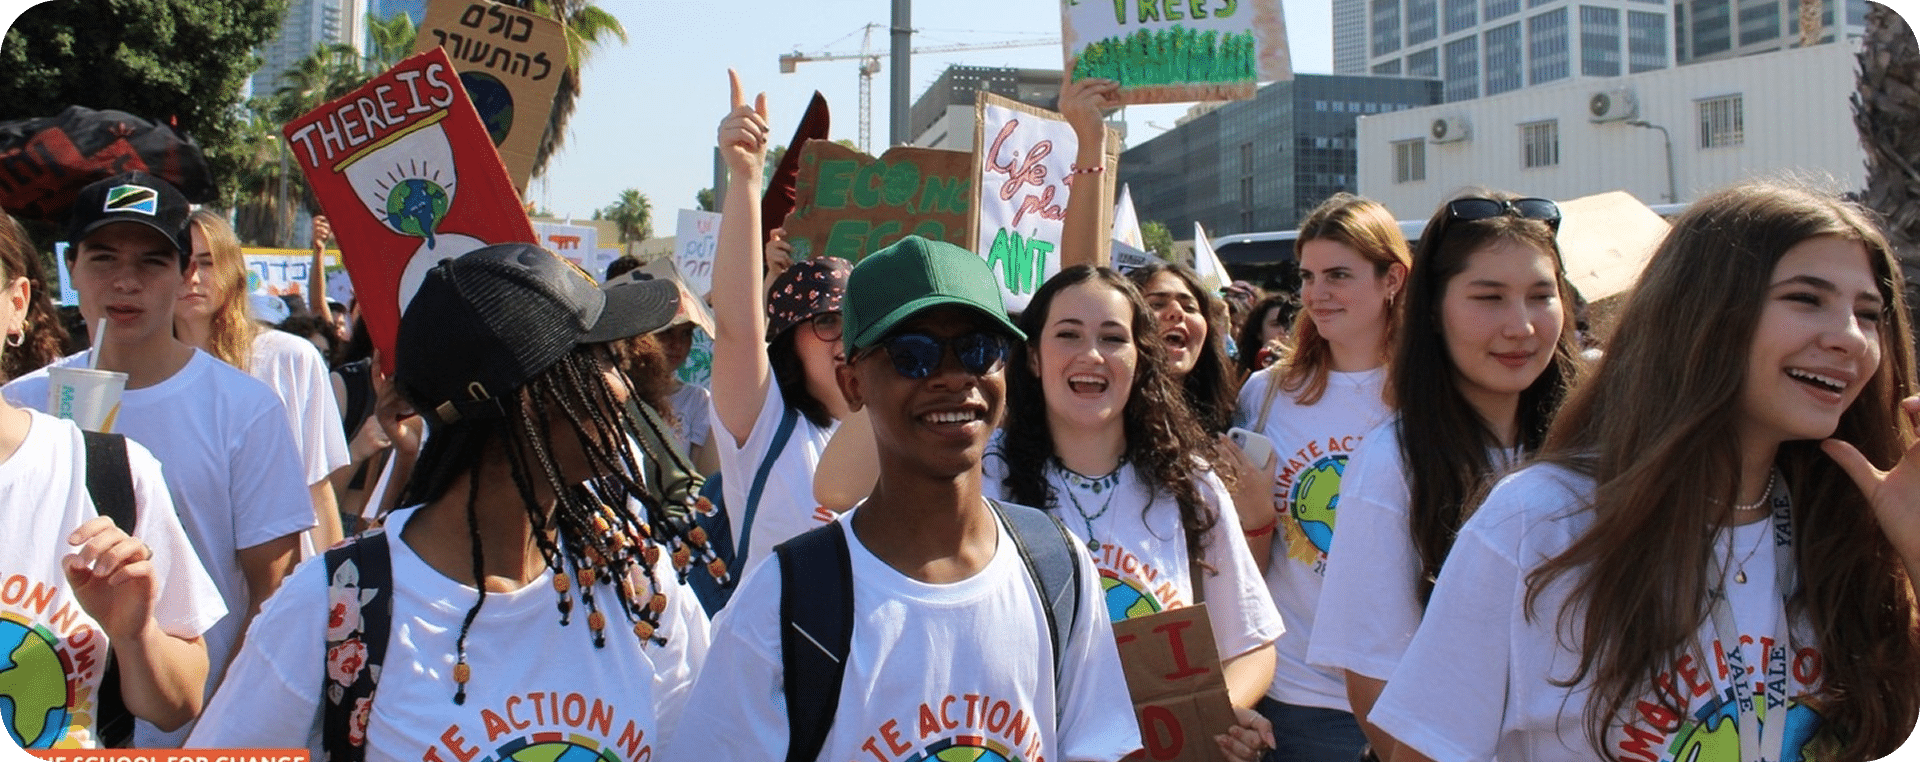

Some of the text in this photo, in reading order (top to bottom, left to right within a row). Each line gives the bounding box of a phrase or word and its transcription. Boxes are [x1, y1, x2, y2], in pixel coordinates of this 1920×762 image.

[460, 4, 533, 42] כולם
[291, 63, 454, 167] THERE IS
[985, 119, 1053, 201] Life
[1273, 440, 1323, 514] CLIMATE
[1773, 495, 1792, 547] YALE
[1093, 544, 1158, 582] TION
[0, 573, 58, 615] ON
[1726, 645, 1754, 713] YALE
[1767, 645, 1787, 710] YALE
[480, 692, 614, 742] ACTION
[918, 694, 1030, 747] ACTION
